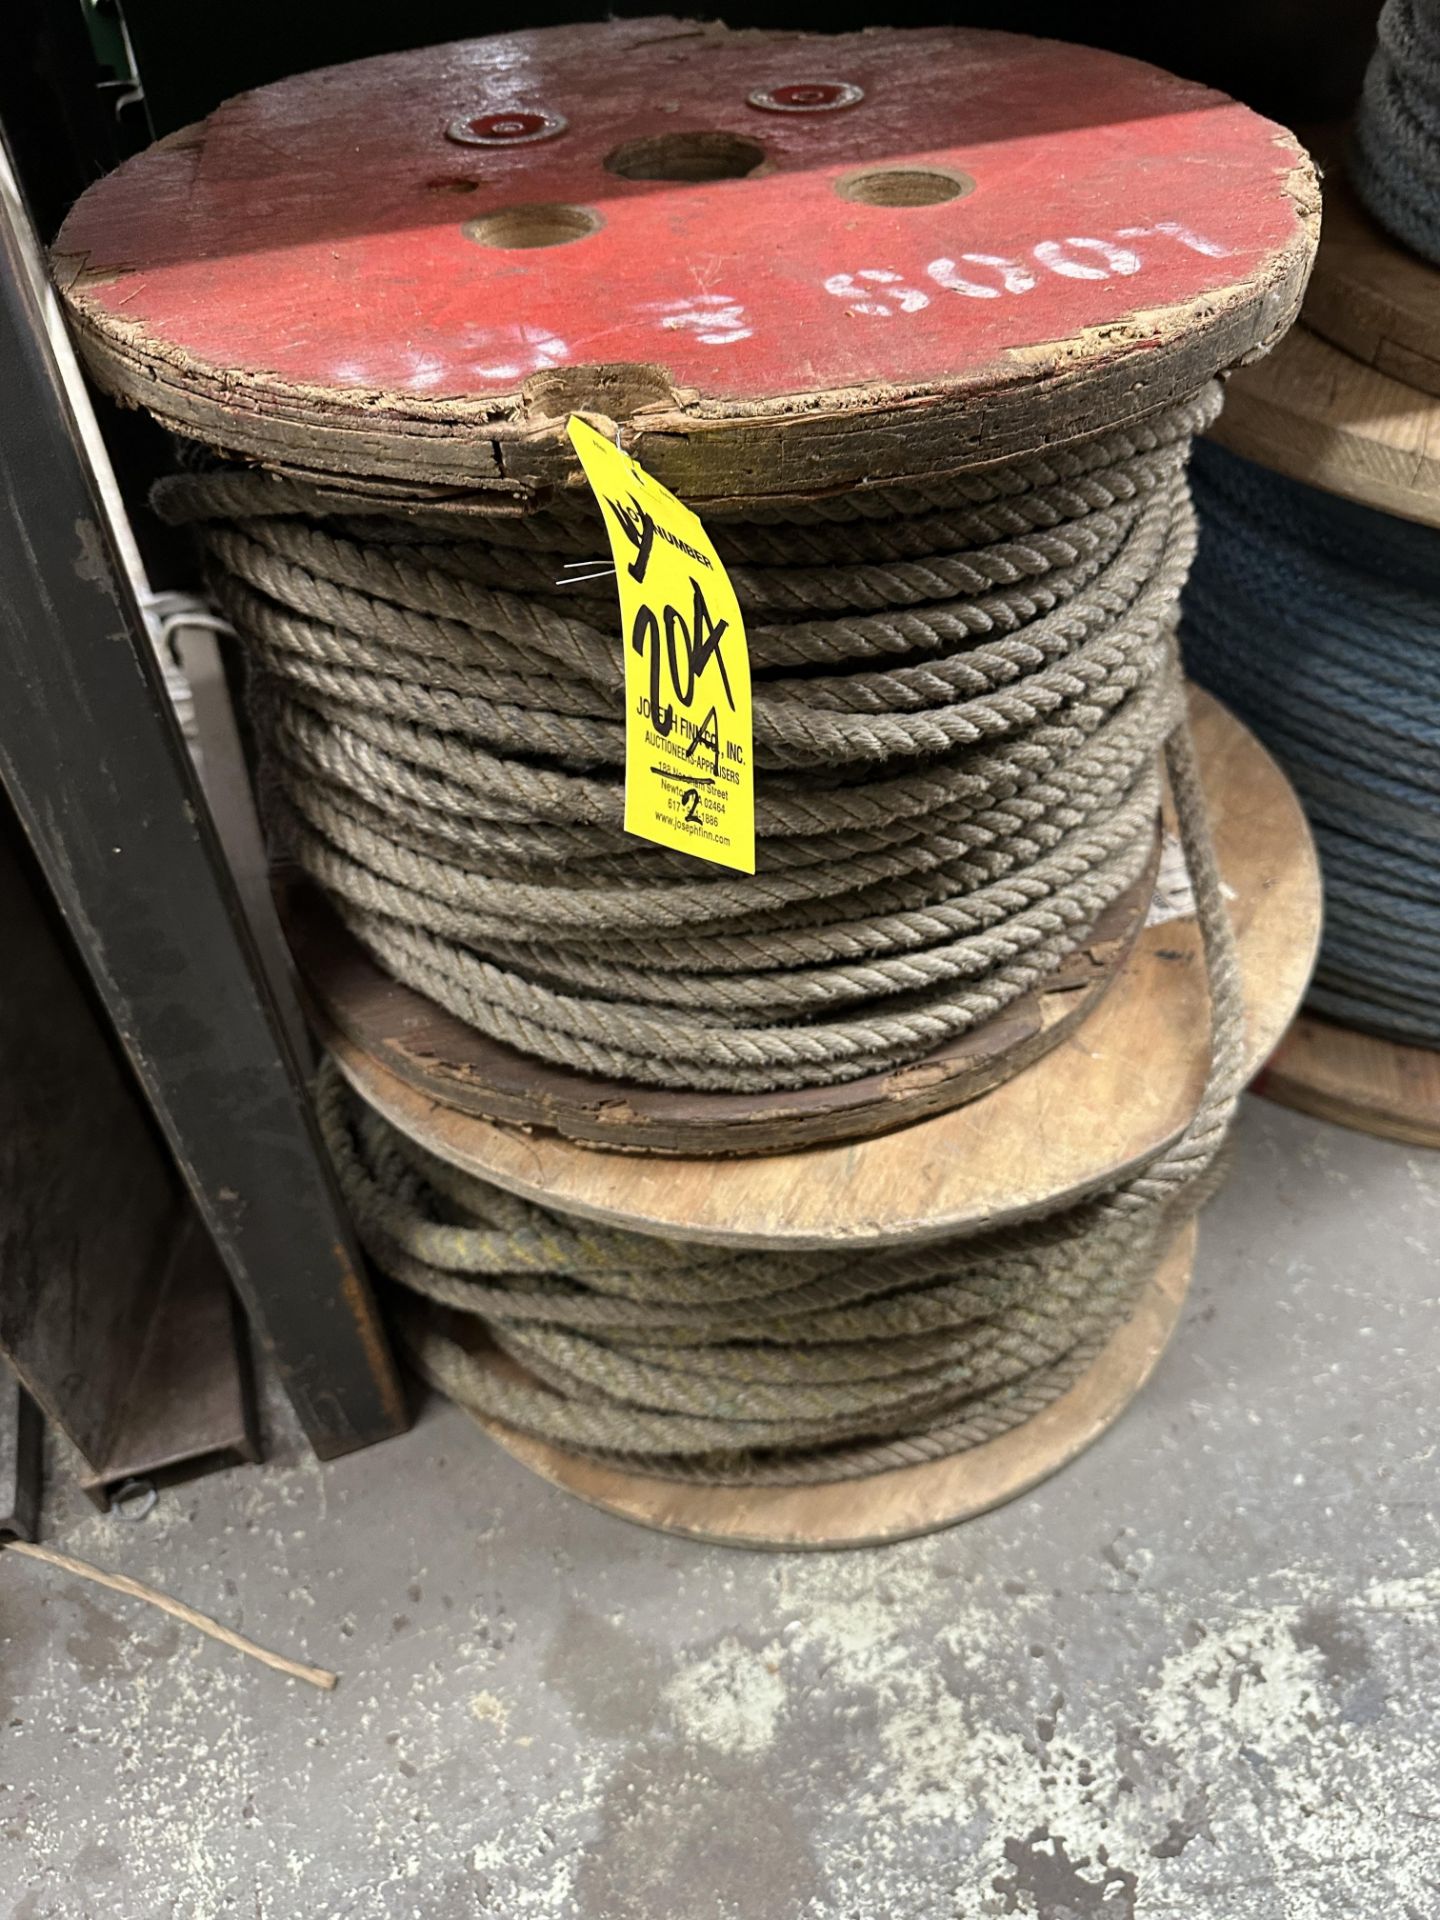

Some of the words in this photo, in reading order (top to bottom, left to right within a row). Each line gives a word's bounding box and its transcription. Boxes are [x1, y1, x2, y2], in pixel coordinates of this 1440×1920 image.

[653, 524, 714, 571] NUMBER
[636, 696, 678, 734] JOEH
[726, 740, 746, 766] INC.
[644, 730, 740, 786] AUCTIONEES-APPRISERS
[681, 788, 703, 826] 2
[704, 797, 726, 814] 02464
[706, 781, 729, 801] Street
[654, 810, 731, 847] www.josephfinn.com
